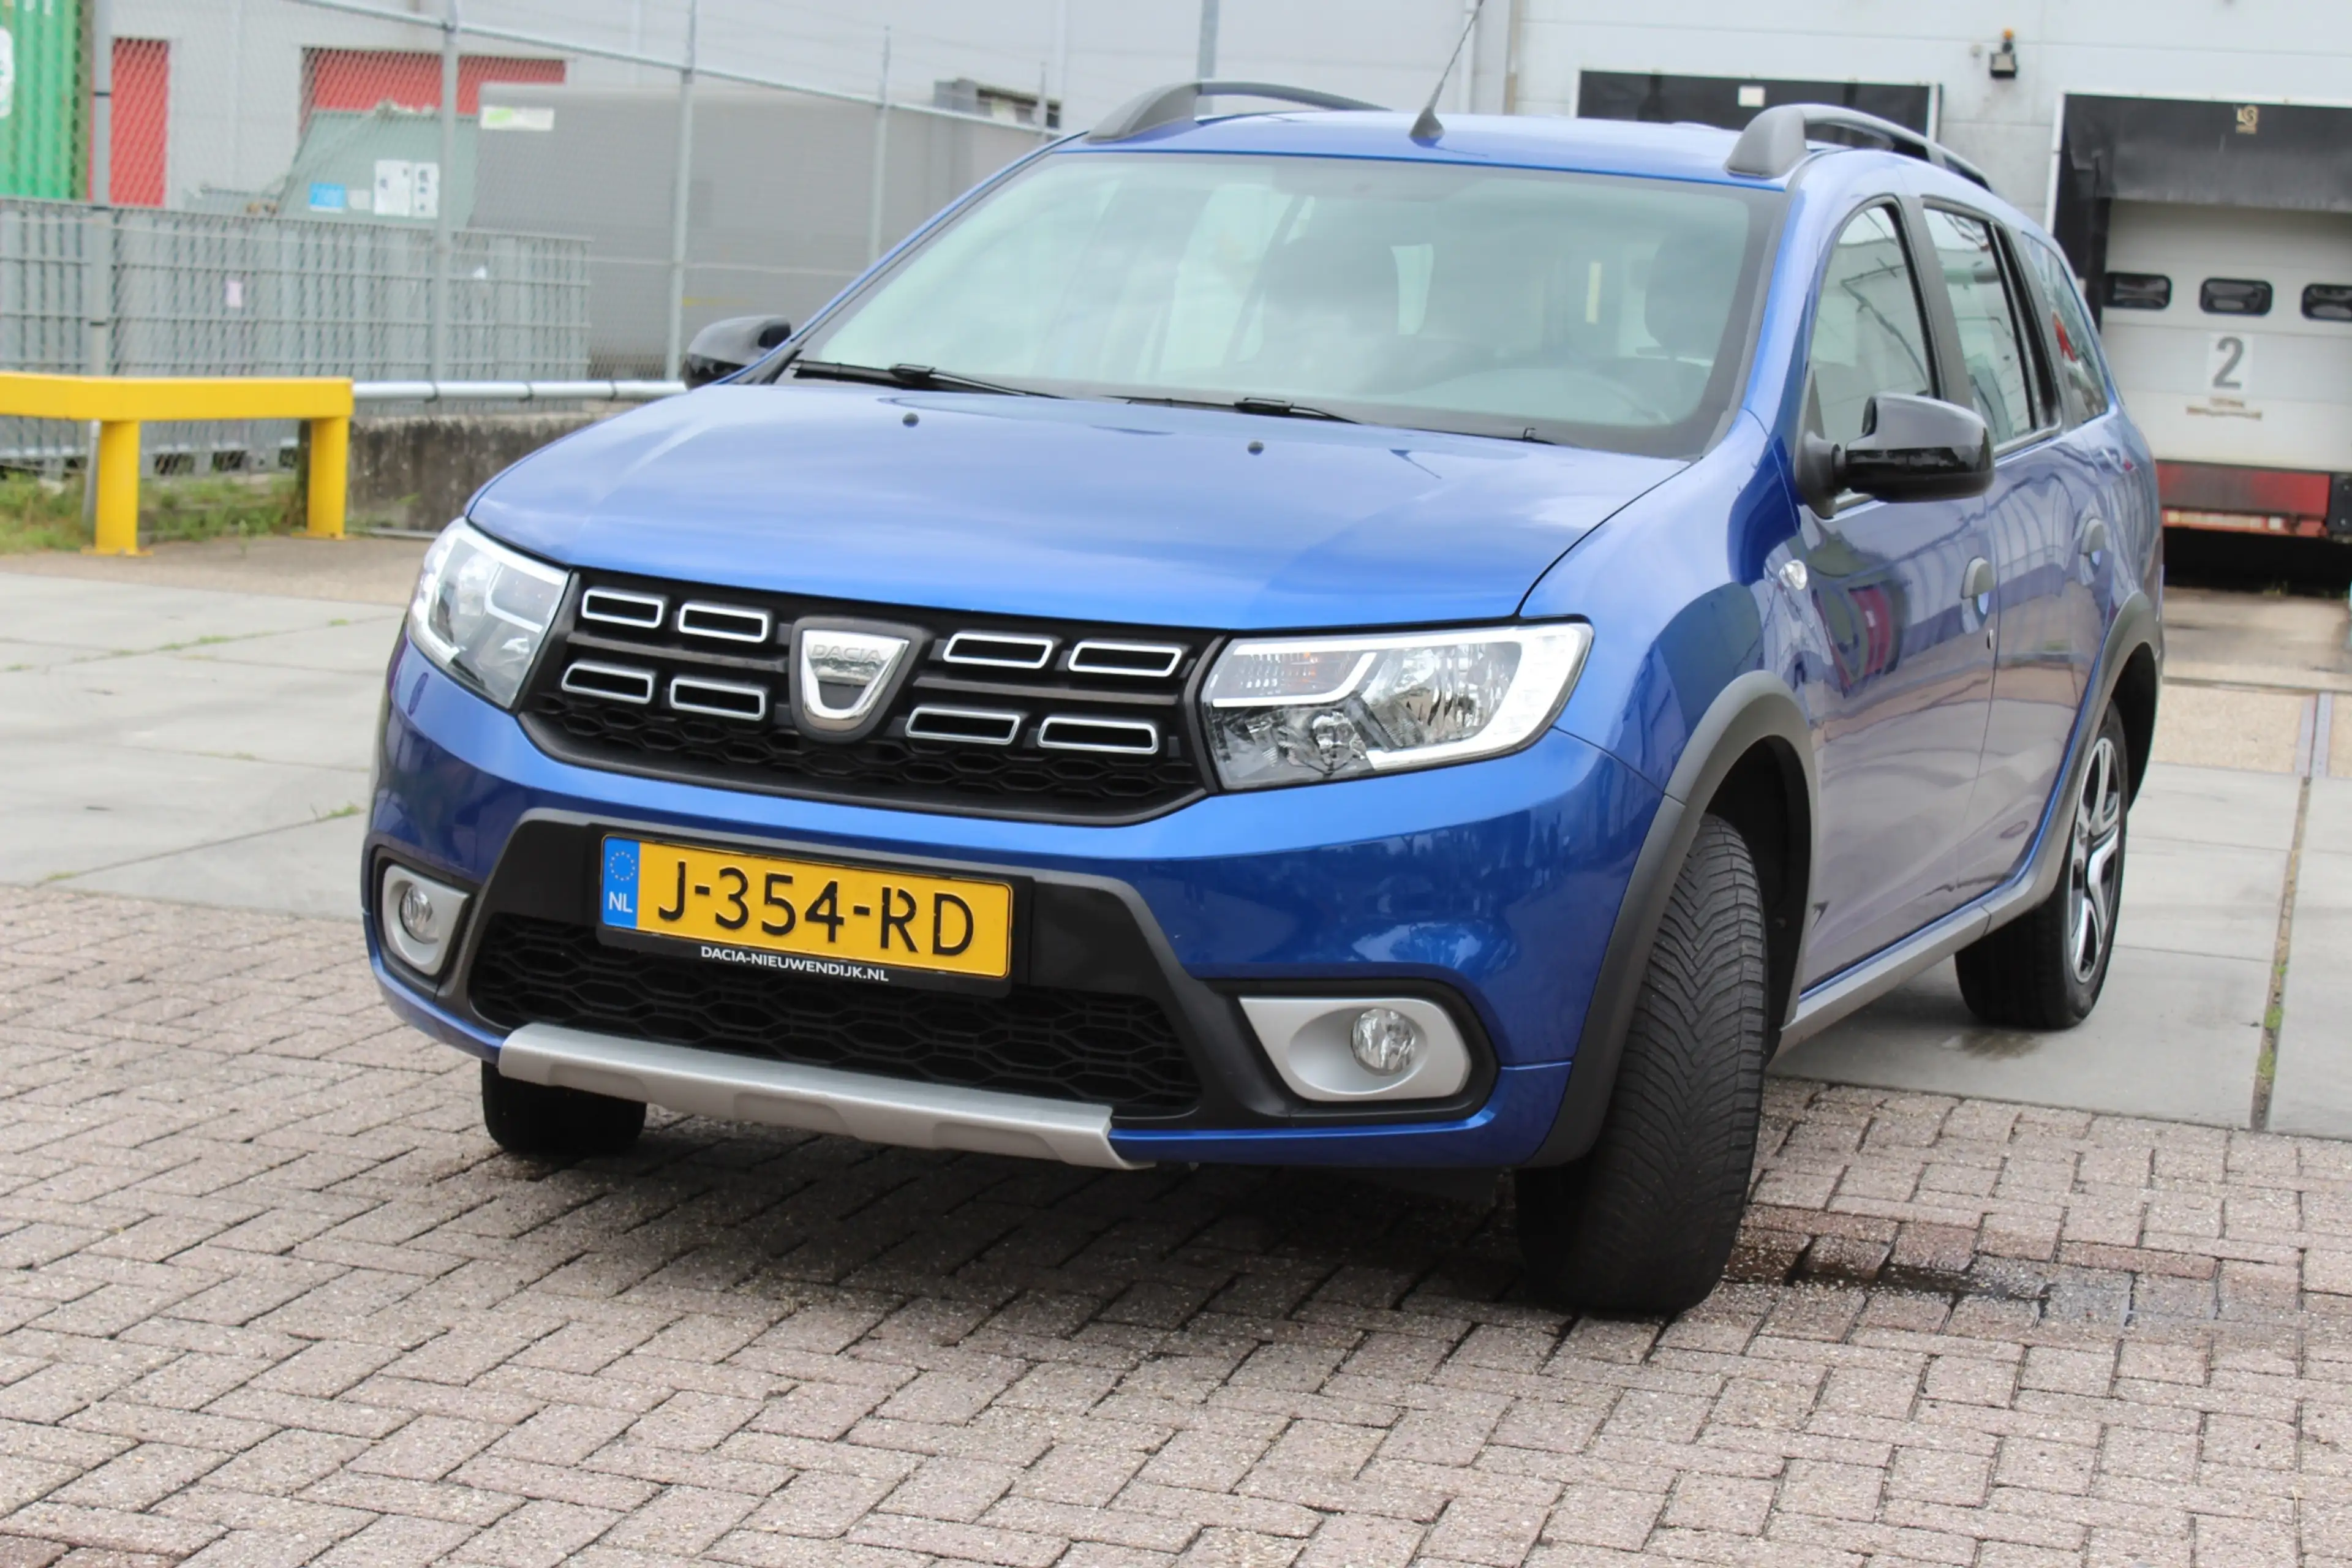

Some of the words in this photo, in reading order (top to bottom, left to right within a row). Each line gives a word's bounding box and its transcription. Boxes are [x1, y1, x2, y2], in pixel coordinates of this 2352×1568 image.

[2212, 336, 2244, 390] 2
[811, 644, 882, 665] DACIA
[609, 891, 633, 913] NL
[658, 861, 973, 956] J-354-RD
[701, 945, 889, 982] DACIA-NIEUWENDIJK.NL
